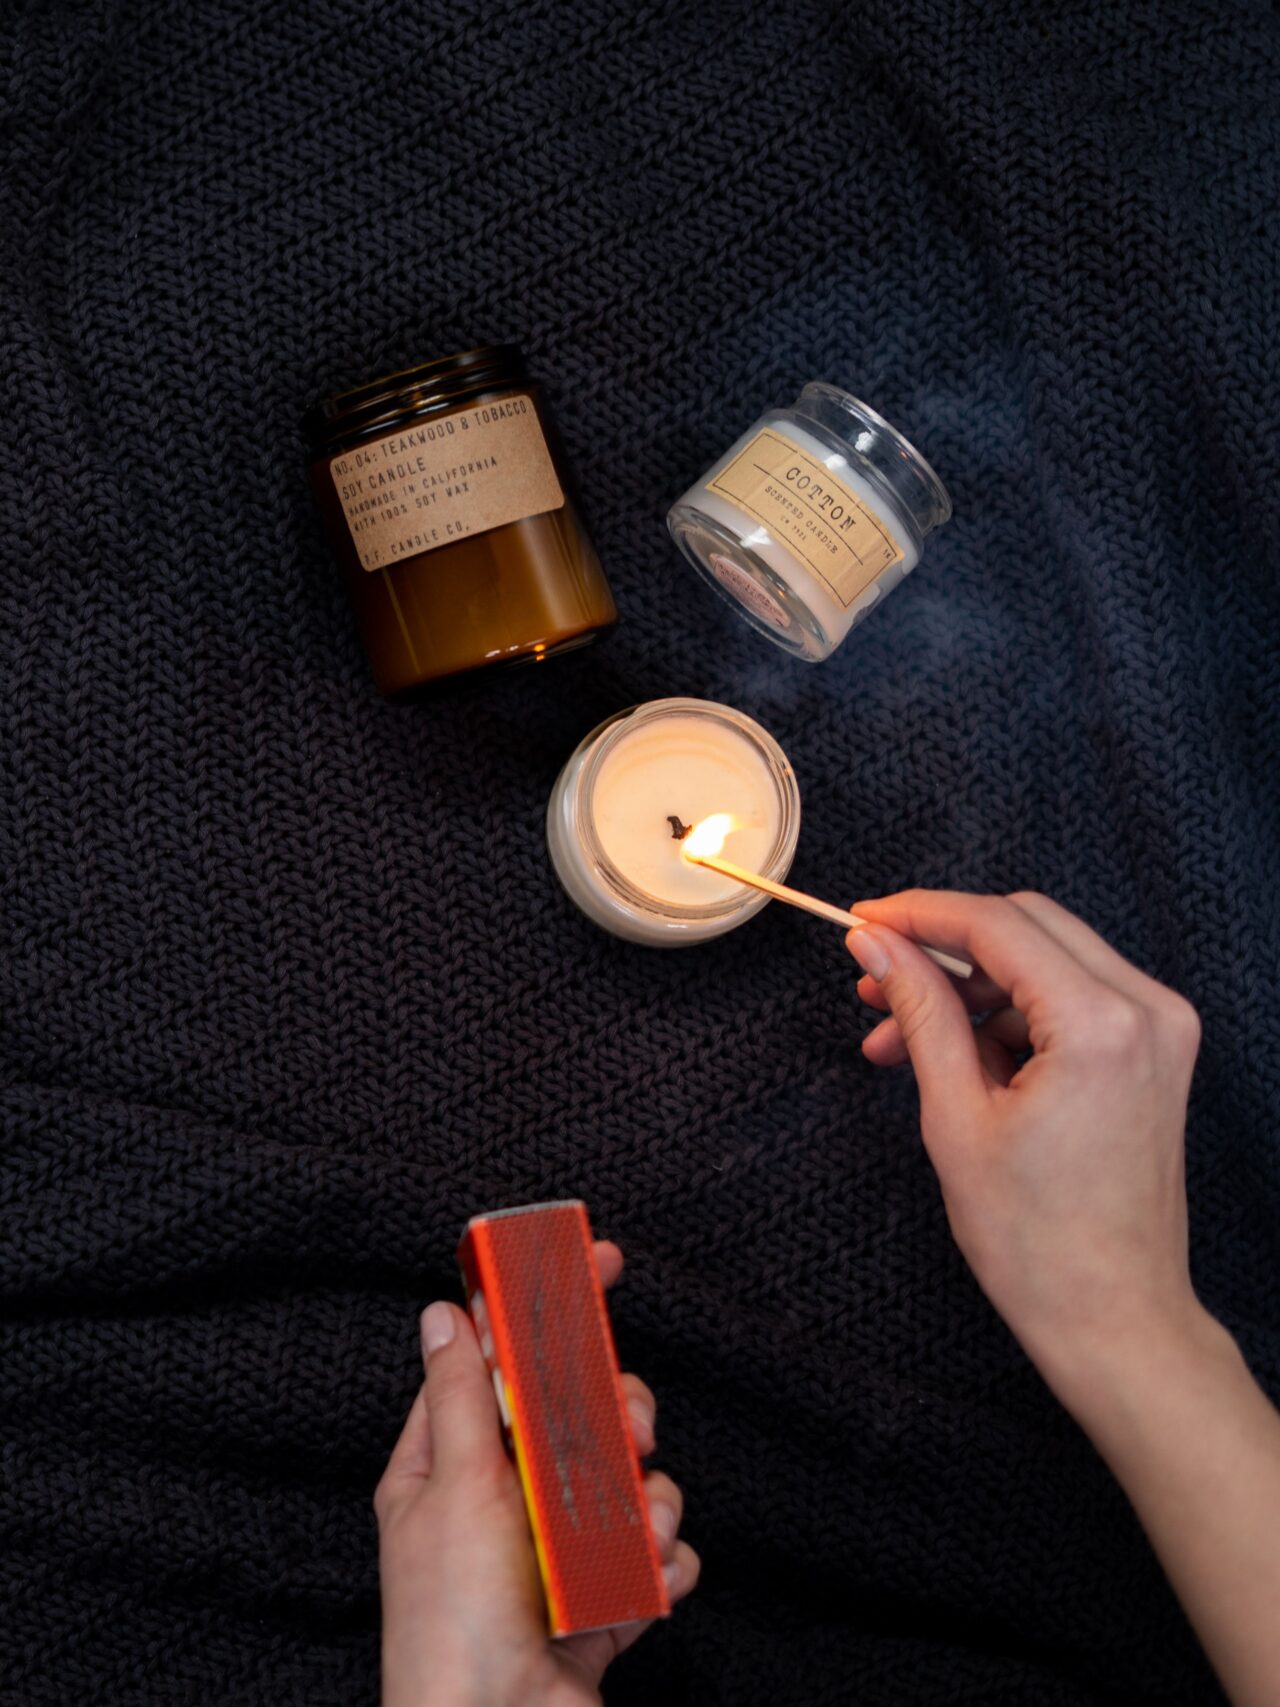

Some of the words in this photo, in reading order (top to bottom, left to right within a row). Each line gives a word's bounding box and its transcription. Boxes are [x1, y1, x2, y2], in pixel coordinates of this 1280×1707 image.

[334, 463, 353, 478] NO.
[356, 454, 378, 468] 04:
[381, 422, 455, 458] TEAKWOOD
[461, 418, 469, 430] &
[475, 400, 527, 426] TOBACCO
[342, 483, 364, 501] SOY
[368, 457, 427, 489] CANDLE
[349, 486, 396, 517] HANDMADE
[404, 482, 416, 495] IN
[422, 457, 498, 488] CALIFORNIA
[353, 516, 376, 533] WITH
[381, 502, 407, 522] 100%
[416, 493, 436, 509] SOY
[446, 483, 470, 498] WAX
[785, 466, 857, 532] COTTON
[391, 530, 439, 555] CANDLE
[447, 520, 470, 536] CO.
[764, 485, 804, 526] SCENTED
[806, 518, 839, 555] CANDLE
